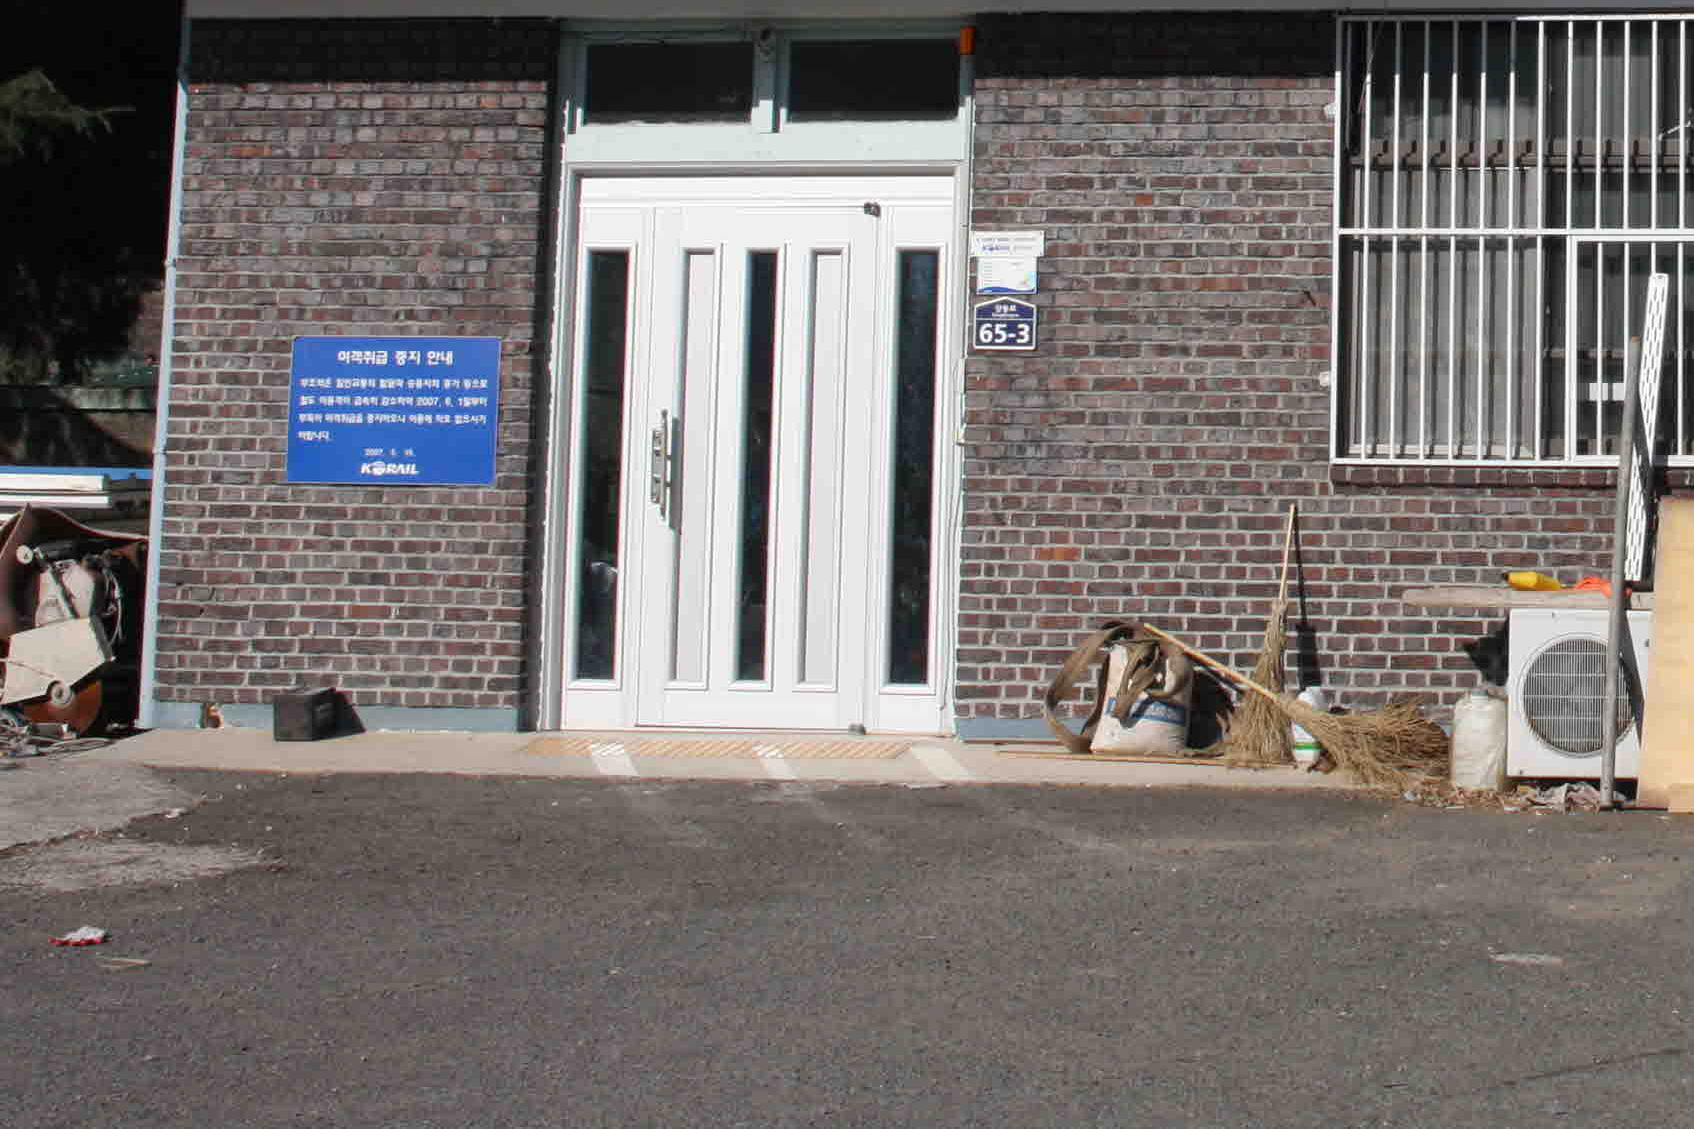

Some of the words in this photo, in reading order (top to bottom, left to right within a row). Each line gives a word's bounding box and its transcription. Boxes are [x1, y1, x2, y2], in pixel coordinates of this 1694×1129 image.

[979, 323, 1030, 343] 65-3
[426, 350, 454, 366] 안내
[360, 461, 420, 476] KORAIL
